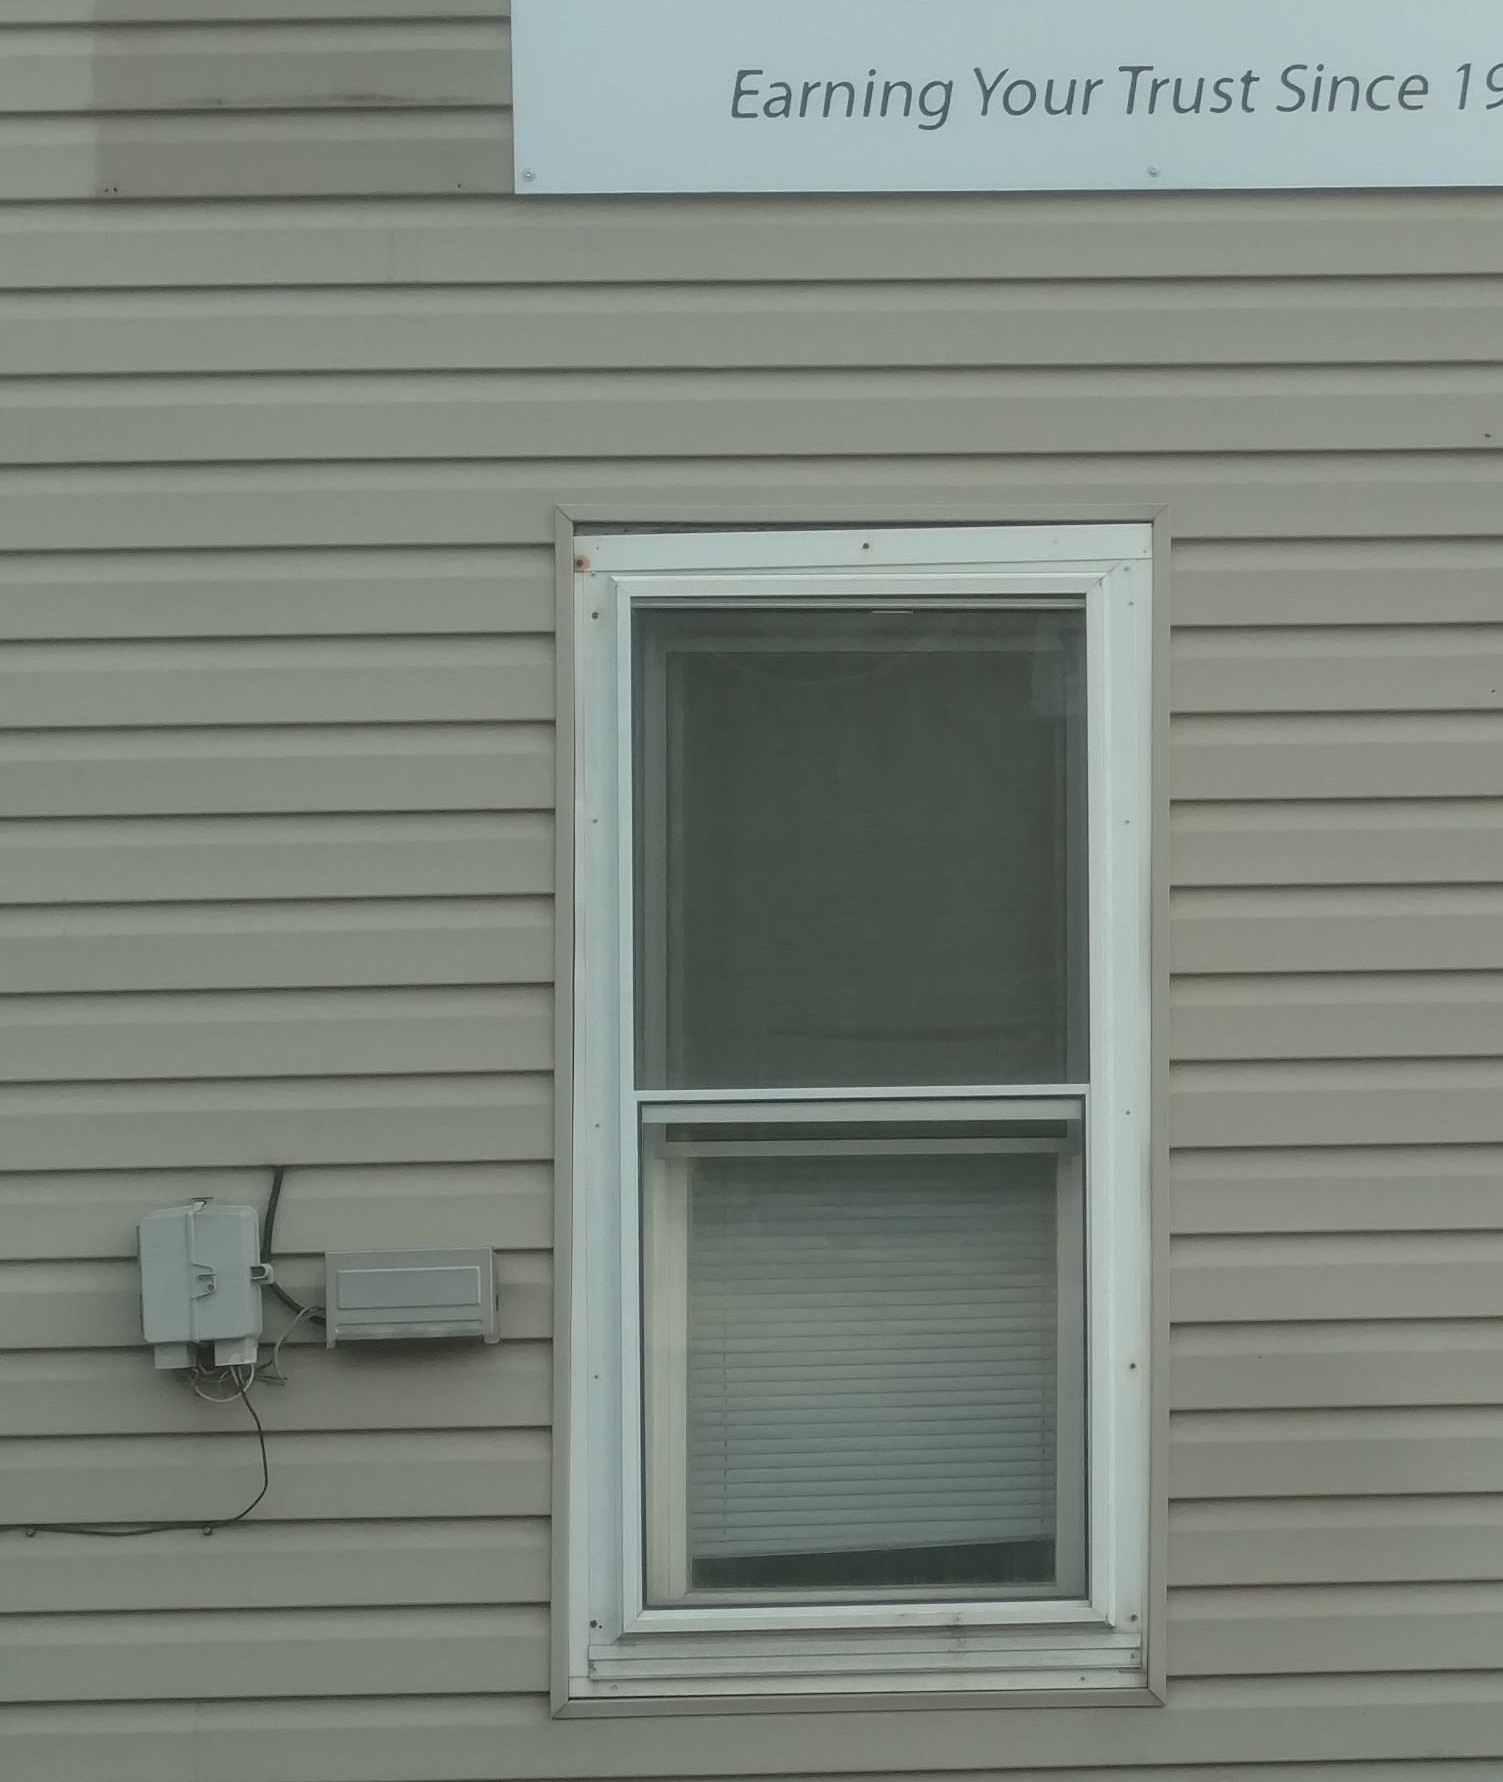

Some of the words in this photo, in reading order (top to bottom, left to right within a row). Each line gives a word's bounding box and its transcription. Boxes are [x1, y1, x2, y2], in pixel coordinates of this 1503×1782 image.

[730, 67, 954, 132] Earning
[972, 65, 1105, 118] Your
[1117, 64, 1261, 116] Trust
[1274, 61, 1430, 114] Since
